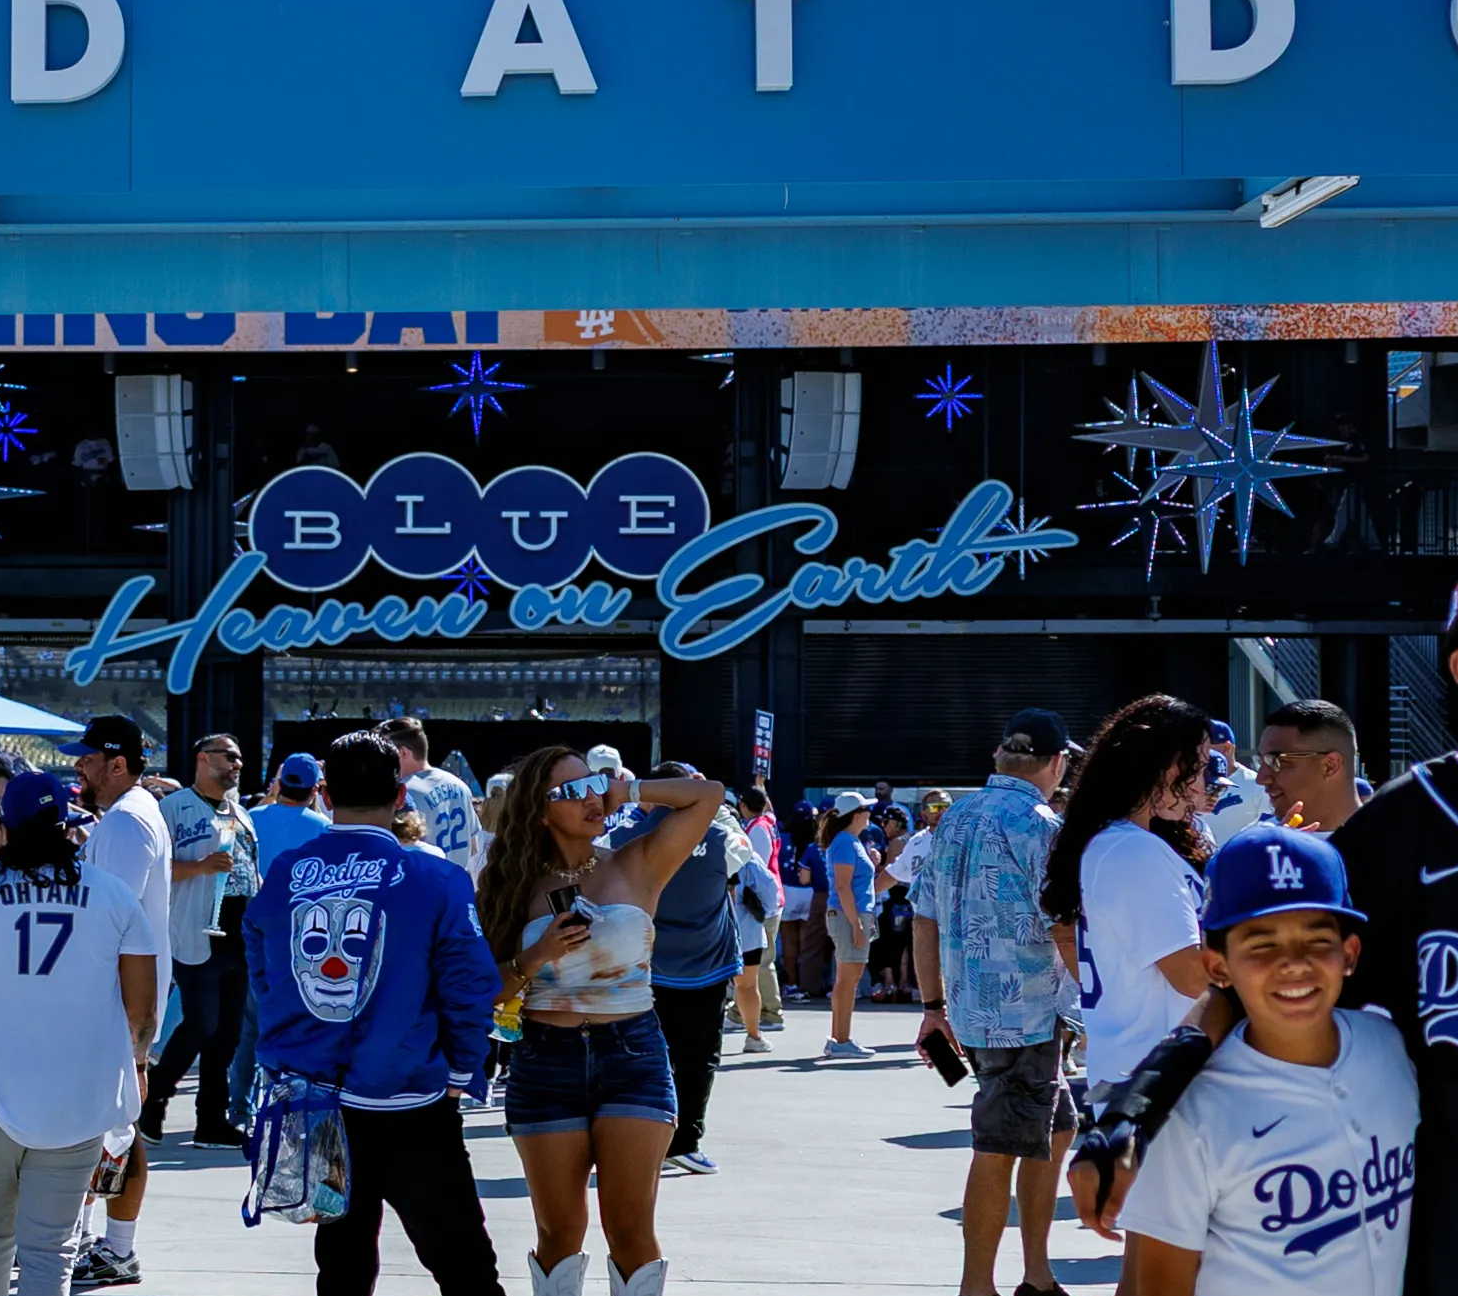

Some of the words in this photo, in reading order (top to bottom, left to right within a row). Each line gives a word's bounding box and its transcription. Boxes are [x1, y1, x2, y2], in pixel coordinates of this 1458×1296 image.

[284, 495, 676, 551] BLUE
[64, 550, 487, 695] Heaven
[509, 580, 633, 633] on
[658, 479, 1079, 661] Earth
[435, 807, 469, 853] 22
[1266, 845, 1304, 890] LA
[0, 883, 91, 909] OHTANI
[14, 911, 75, 976] 17
